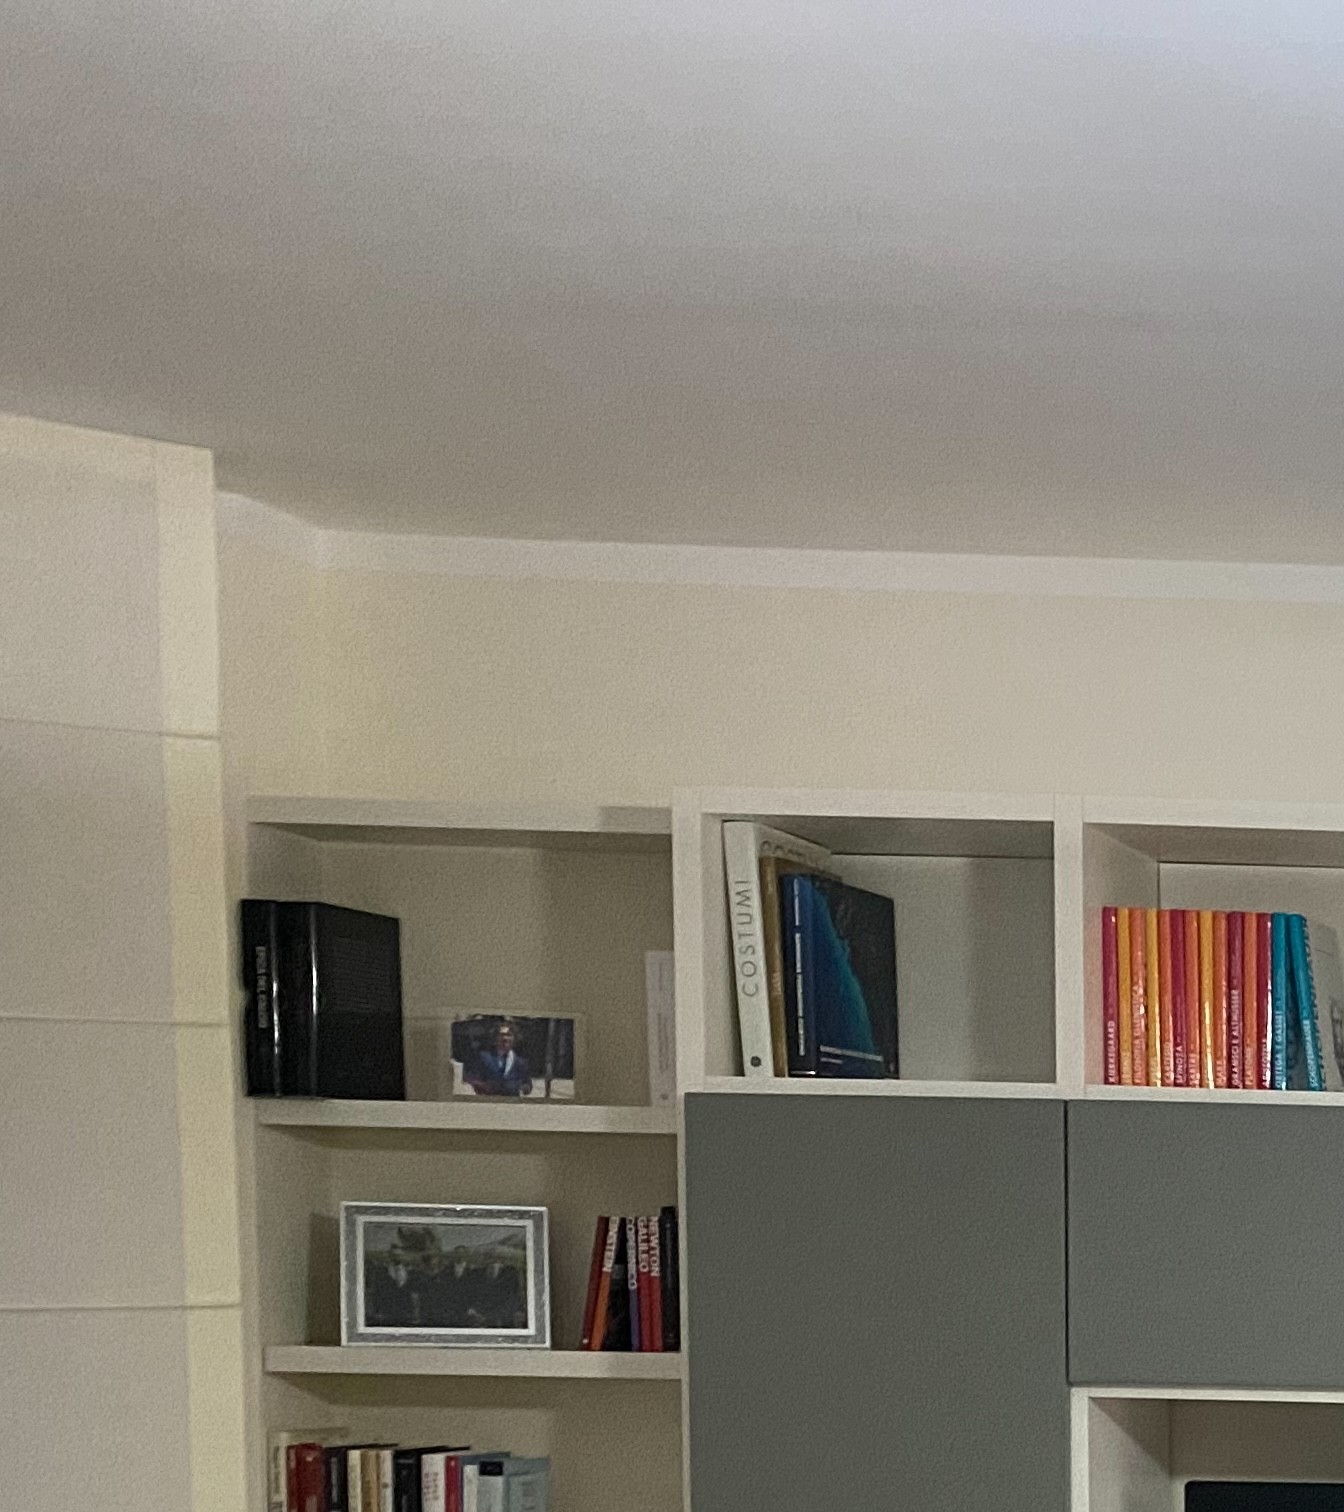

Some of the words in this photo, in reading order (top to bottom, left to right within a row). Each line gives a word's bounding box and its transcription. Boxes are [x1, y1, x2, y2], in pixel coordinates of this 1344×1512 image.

[734, 879, 759, 998] COSTUMI
[1231, 989, 1239, 1037] ALTHUSSER
[1107, 1020, 1116, 1083] KIERKEGAARD
[1175, 1045, 1184, 1084] SPINOZA
[1232, 1045, 1240, 1086] GRAMSCI
[1302, 1019, 1318, 1088] SCHOPENHAUER
[602, 1216, 620, 1273] EINSTEIN
[638, 1216, 649, 1272] GALILEO
[649, 1216, 660, 1277] NEWTON
